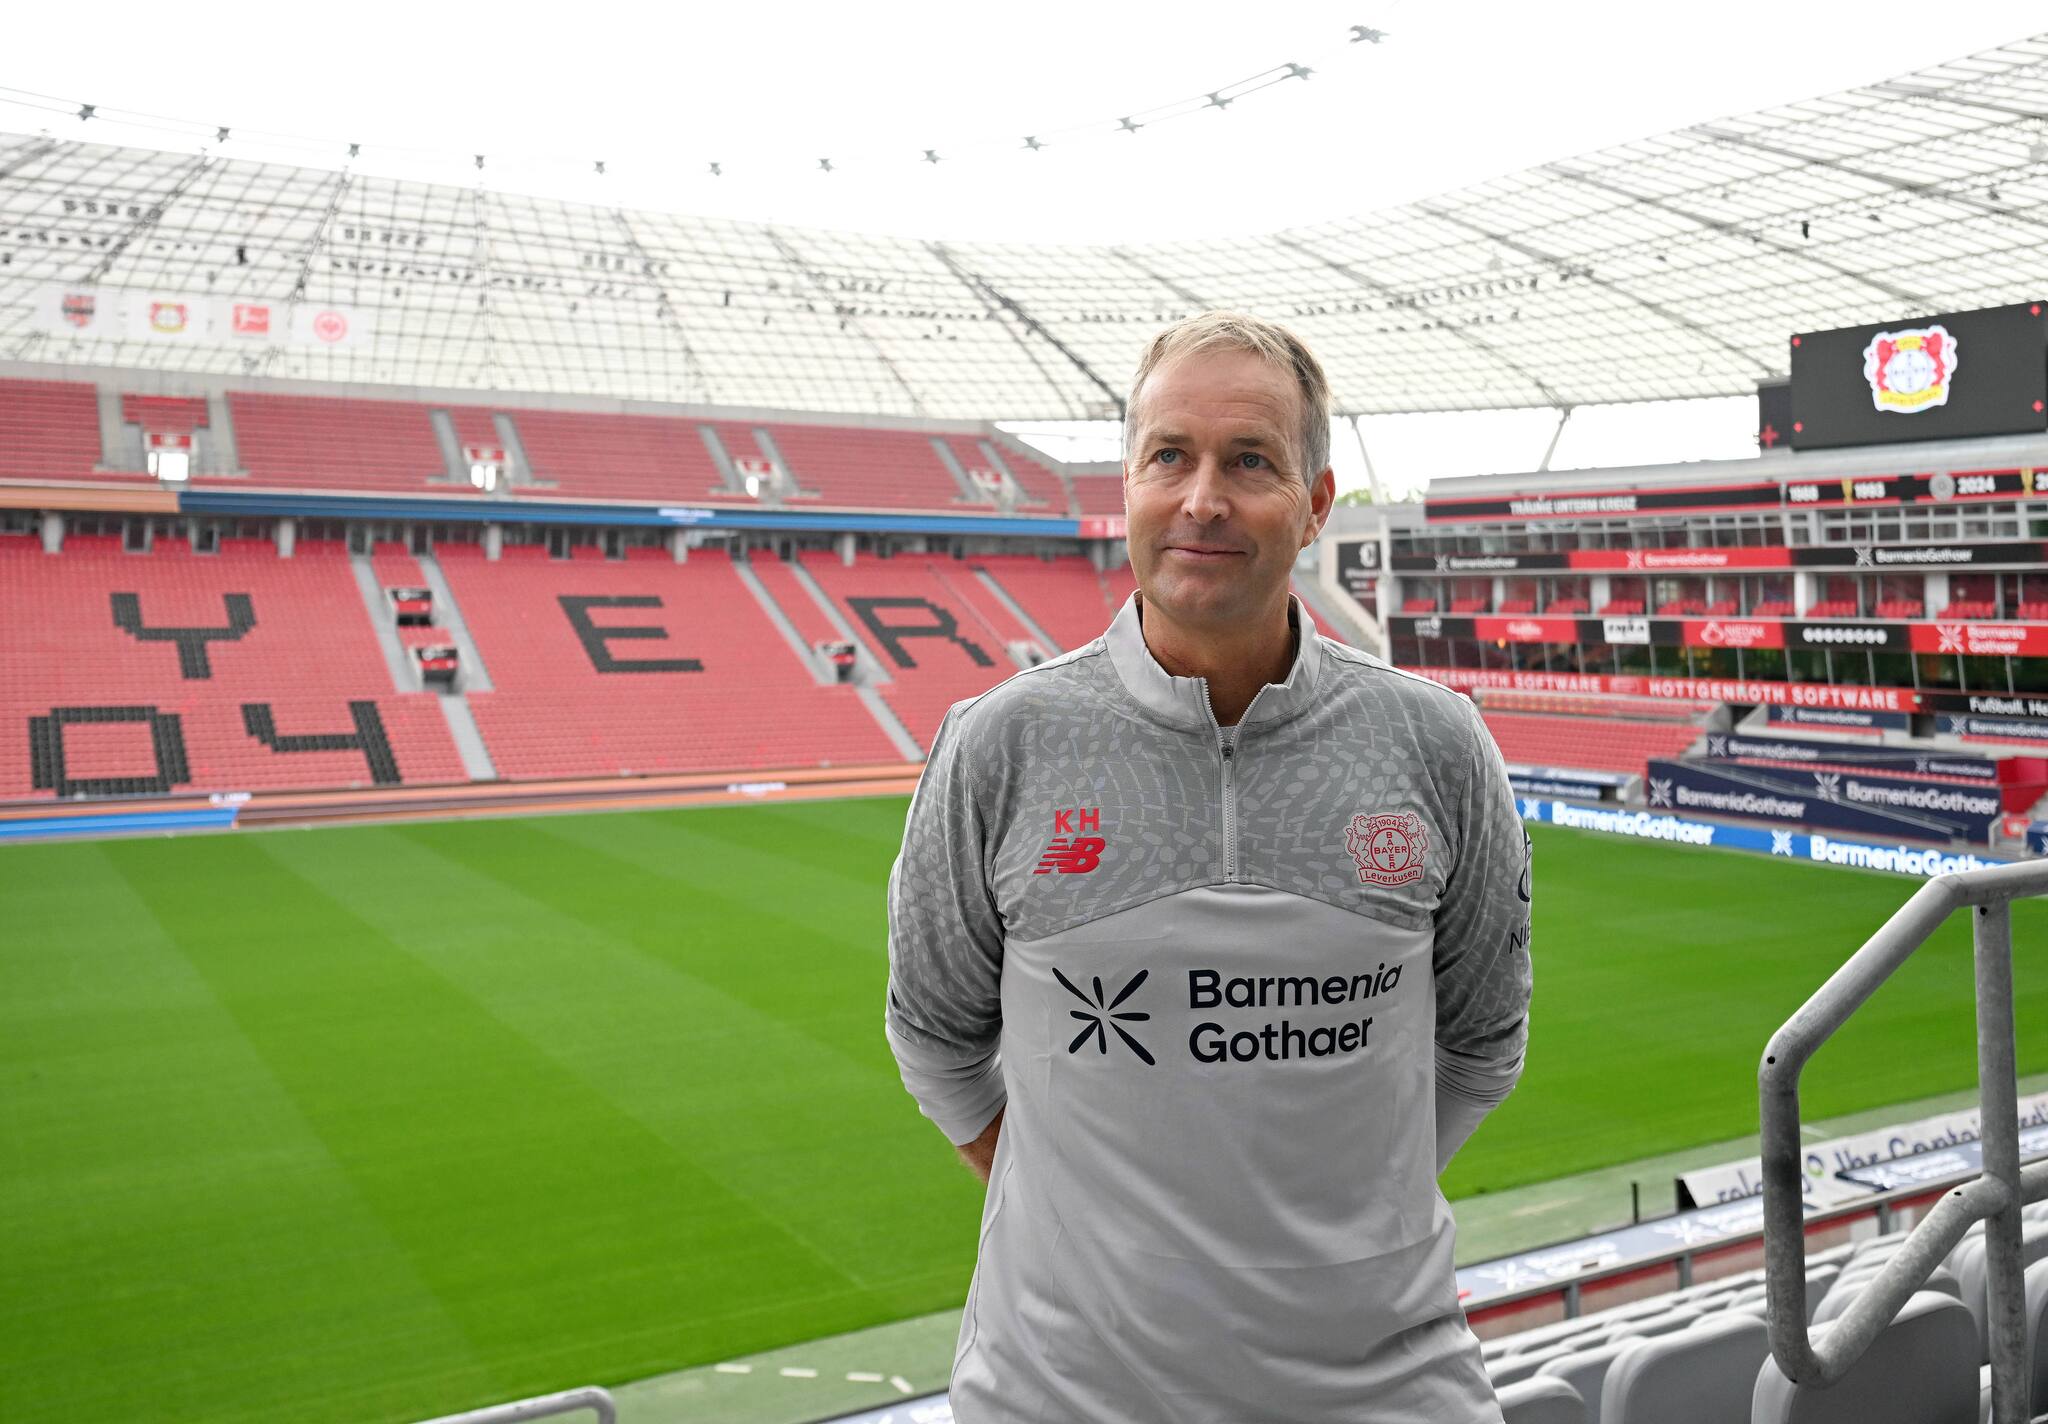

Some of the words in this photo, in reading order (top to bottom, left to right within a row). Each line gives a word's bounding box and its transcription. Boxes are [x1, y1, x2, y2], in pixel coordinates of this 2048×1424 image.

[1958, 475, 1996, 494] 2024
[1875, 548, 1973, 564] BarmeniaGothaer
[1514, 672, 1601, 693] SOFTWARE
[1649, 680, 1785, 703] HOTTGENROTH
[1791, 685, 1899, 710] SOFTWARE
[1728, 740, 1819, 760] BarmeniaGothaer
[1677, 785, 1806, 818] BarmeniaGothaer
[1846, 780, 1998, 815] BarmeniaGothaer
[1378, 818, 1397, 827] 1904
[1552, 801, 1715, 845] BarmeniaGothaer
[1373, 845, 1408, 855] BAYER
[1385, 831, 1396, 869] BAYER
[1365, 869, 1419, 883] Leverkusen
[1188, 961, 1403, 1010] Barmenia
[1188, 1015, 1372, 1063] Gothaer
